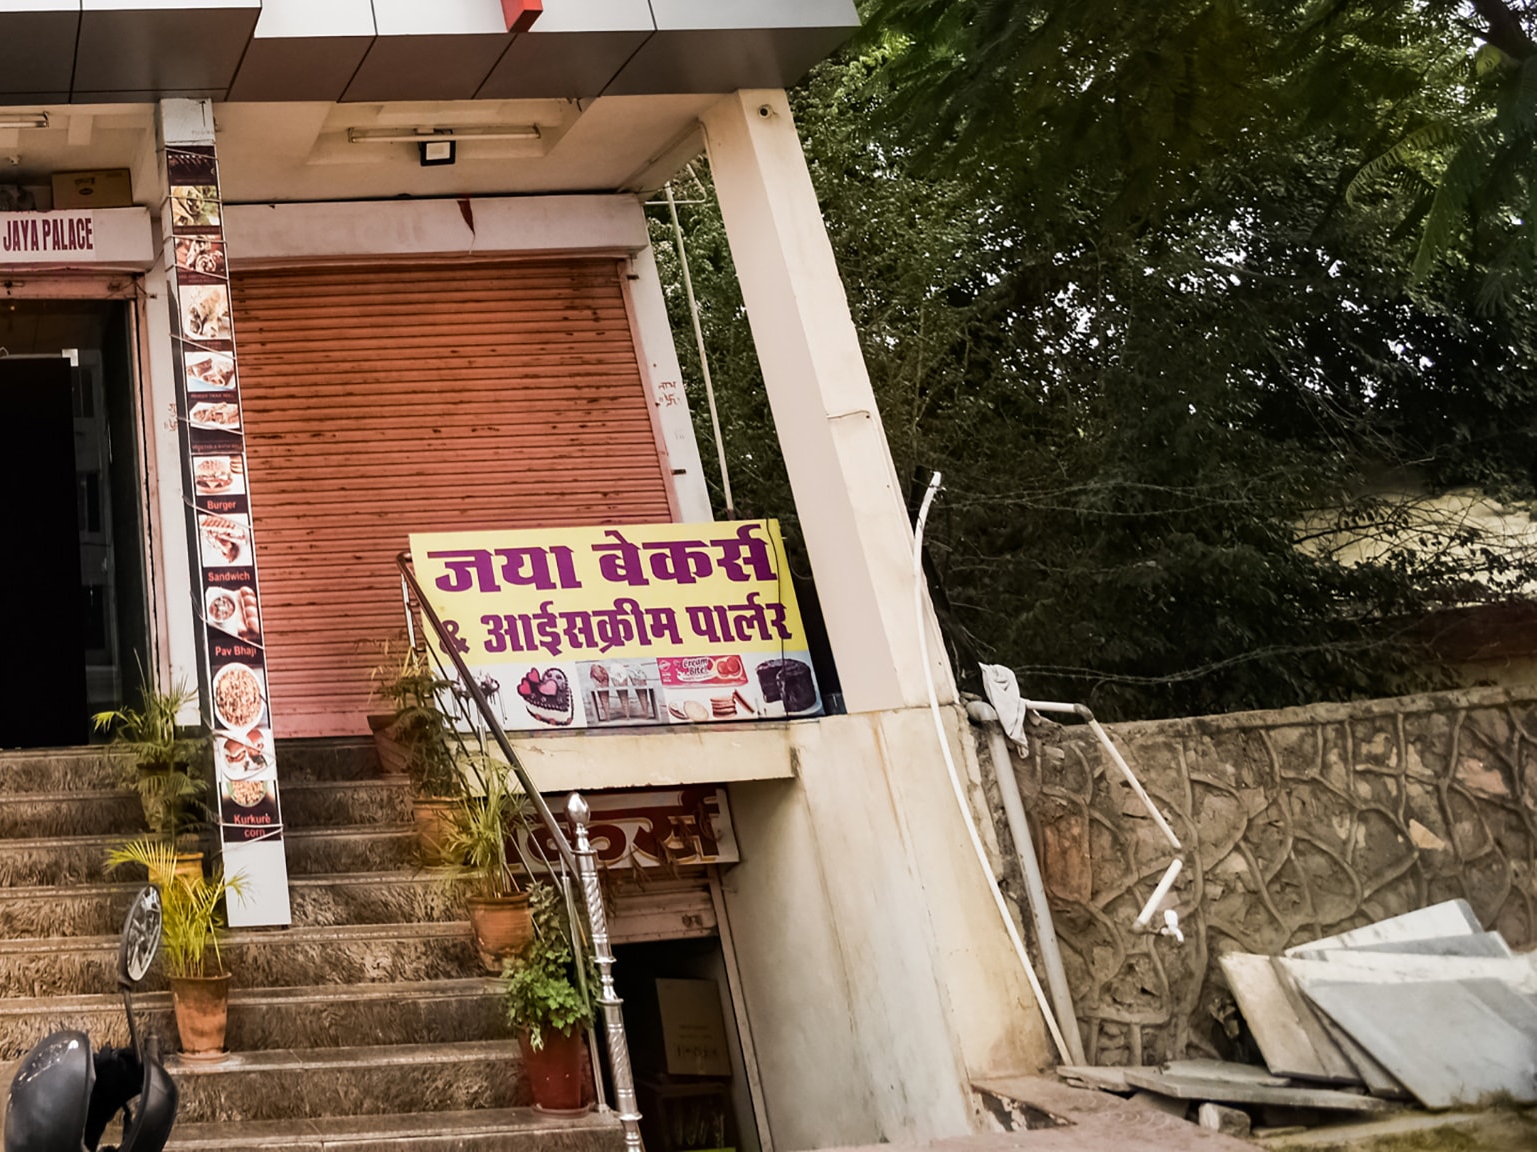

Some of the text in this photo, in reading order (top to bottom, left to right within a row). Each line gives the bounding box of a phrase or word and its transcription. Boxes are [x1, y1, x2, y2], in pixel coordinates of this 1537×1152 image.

[3, 219, 39, 251] JAYA
[42, 217, 93, 250] PALACE
[207, 500, 236, 511] Burger
[427, 523, 778, 593] जया बेकर्स
[208, 571, 250, 583] Sandwich
[480, 597, 683, 657] आईसक्रीम
[685, 592, 792, 644] पार्लर
[215, 644, 257, 658] Pav Bhaji
